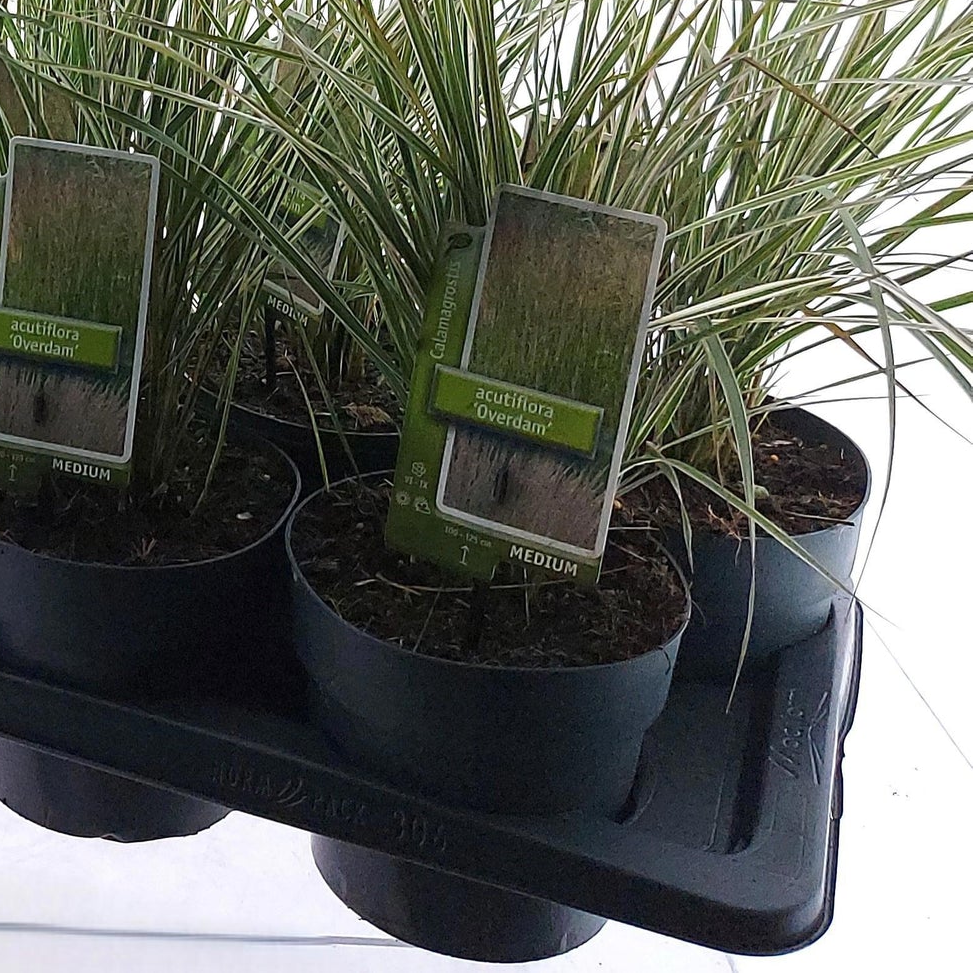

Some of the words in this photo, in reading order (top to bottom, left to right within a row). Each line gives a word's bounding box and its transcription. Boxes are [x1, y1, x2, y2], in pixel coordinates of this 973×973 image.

[429, 259, 461, 360] Calamagrostis
[10, 320, 80, 341] acutiflora
[475, 387, 554, 419] acutiflora
[52, 457, 112, 482] MEDIUM
[509, 544, 578, 577] MEDIUM
